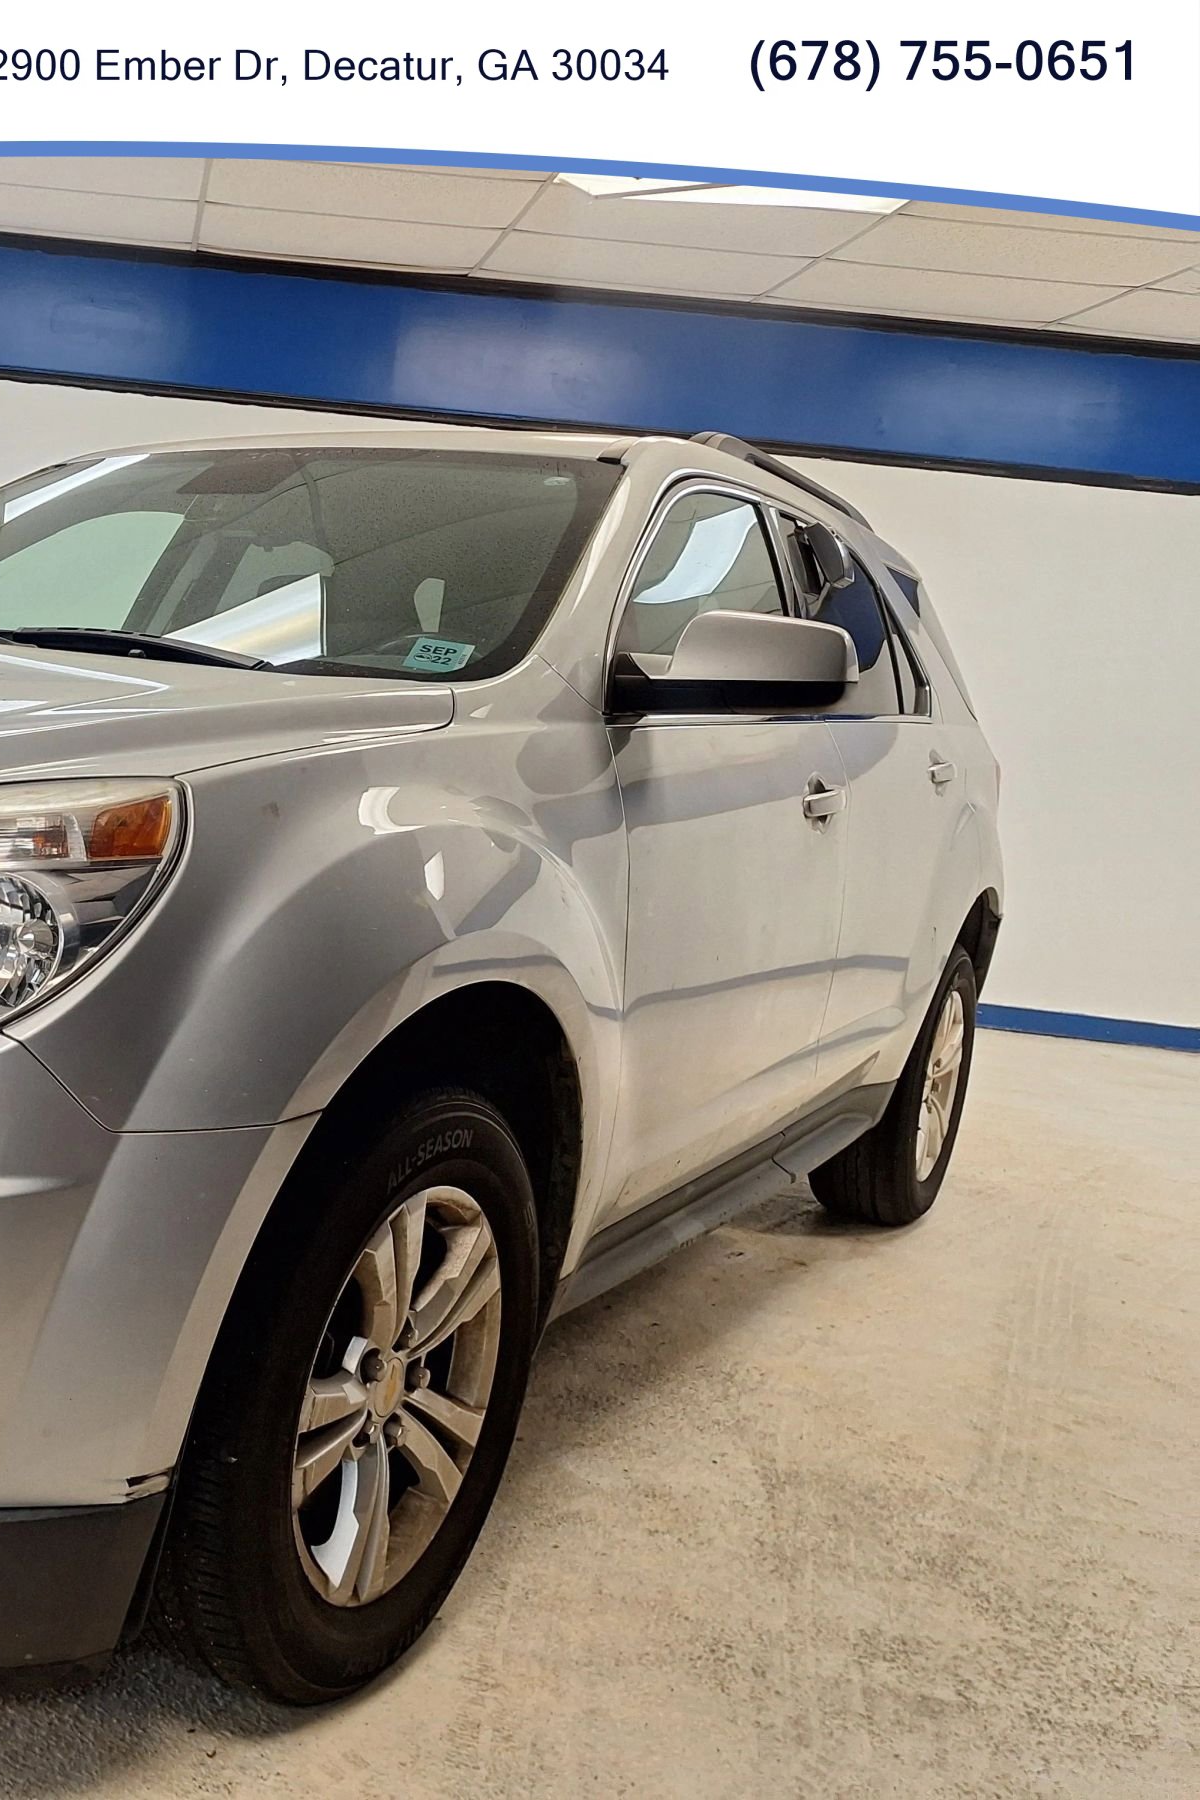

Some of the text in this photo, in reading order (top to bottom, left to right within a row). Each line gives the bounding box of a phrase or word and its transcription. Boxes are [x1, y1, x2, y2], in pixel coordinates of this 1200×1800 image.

[419, 644, 458, 656] SEP
[431, 655, 452, 665] 22
[387, 1129, 474, 1195] ALL-SEASON
